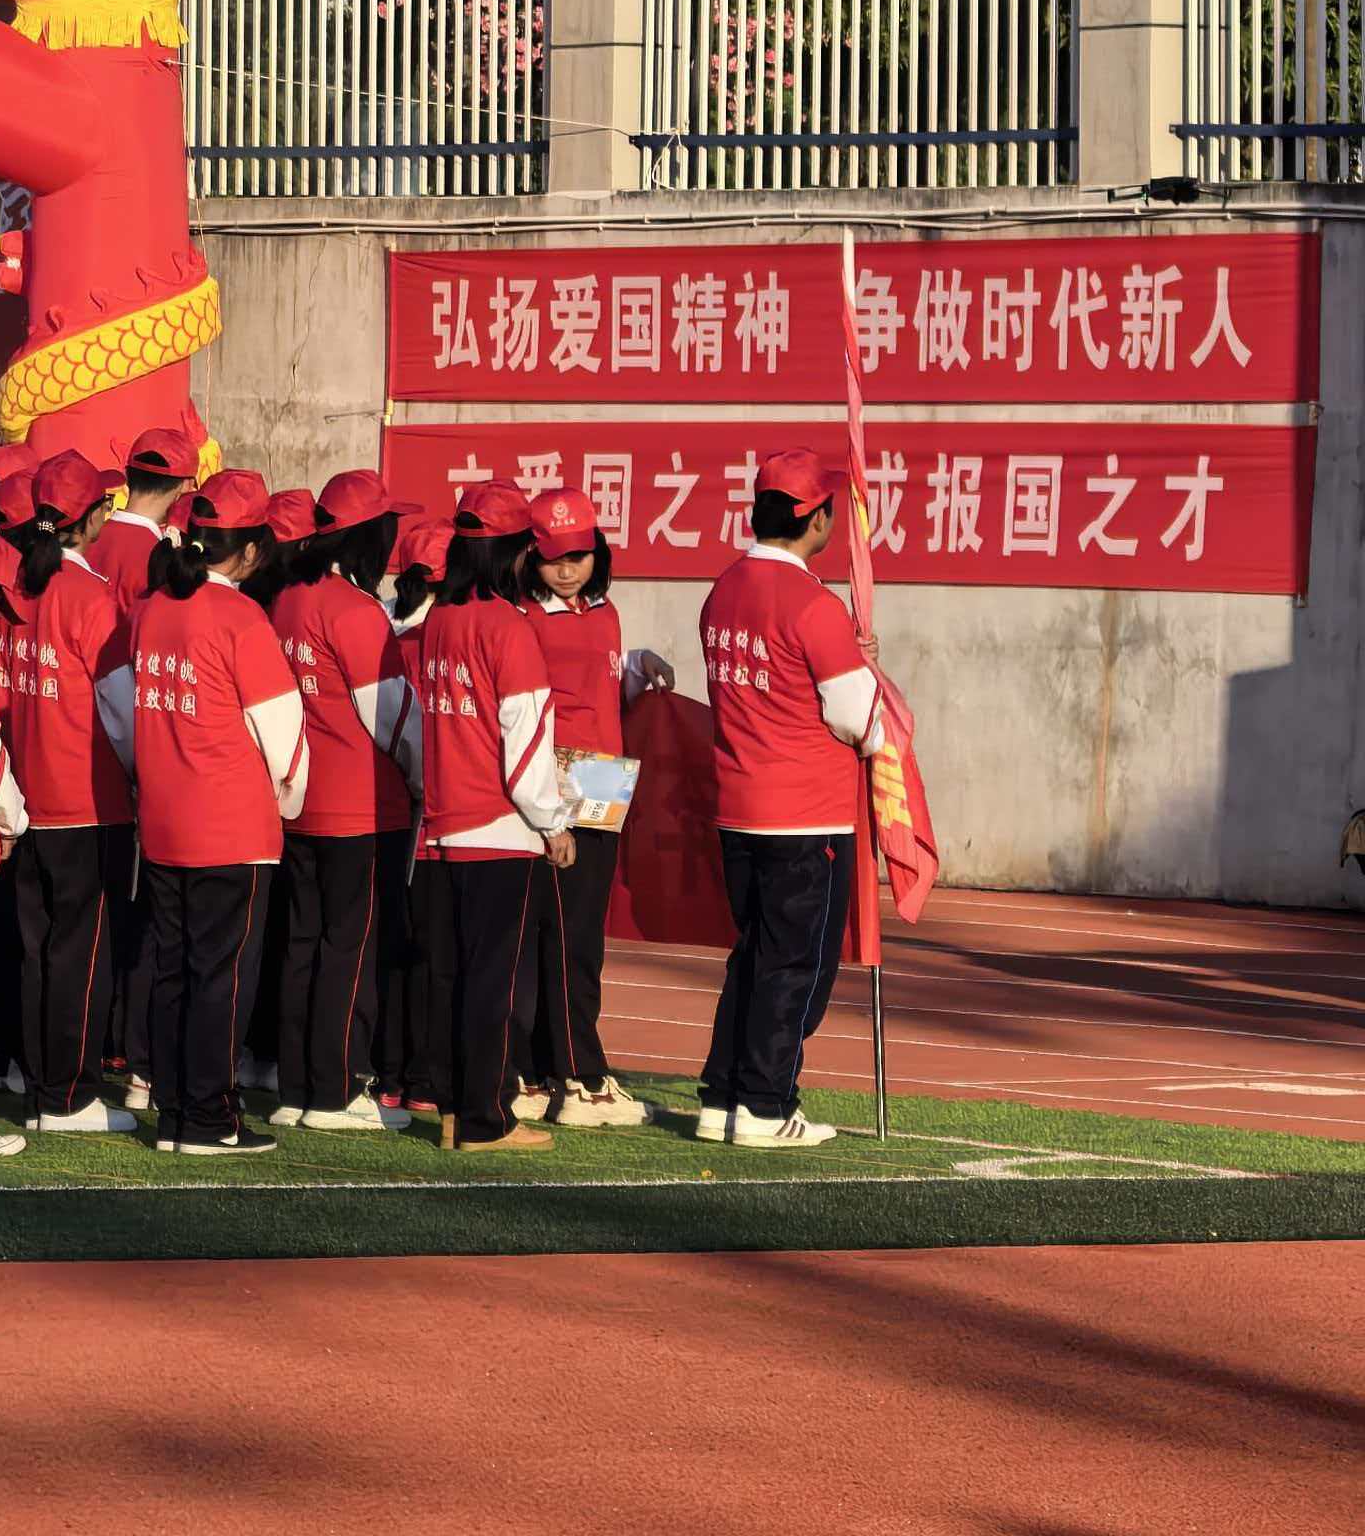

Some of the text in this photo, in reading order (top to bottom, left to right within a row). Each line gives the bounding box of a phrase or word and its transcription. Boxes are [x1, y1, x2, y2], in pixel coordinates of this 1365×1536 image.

[431, 263, 1253, 376] 弘扬爱国精神 争做时代新人
[864, 451, 1226, 562] 成报国之才
